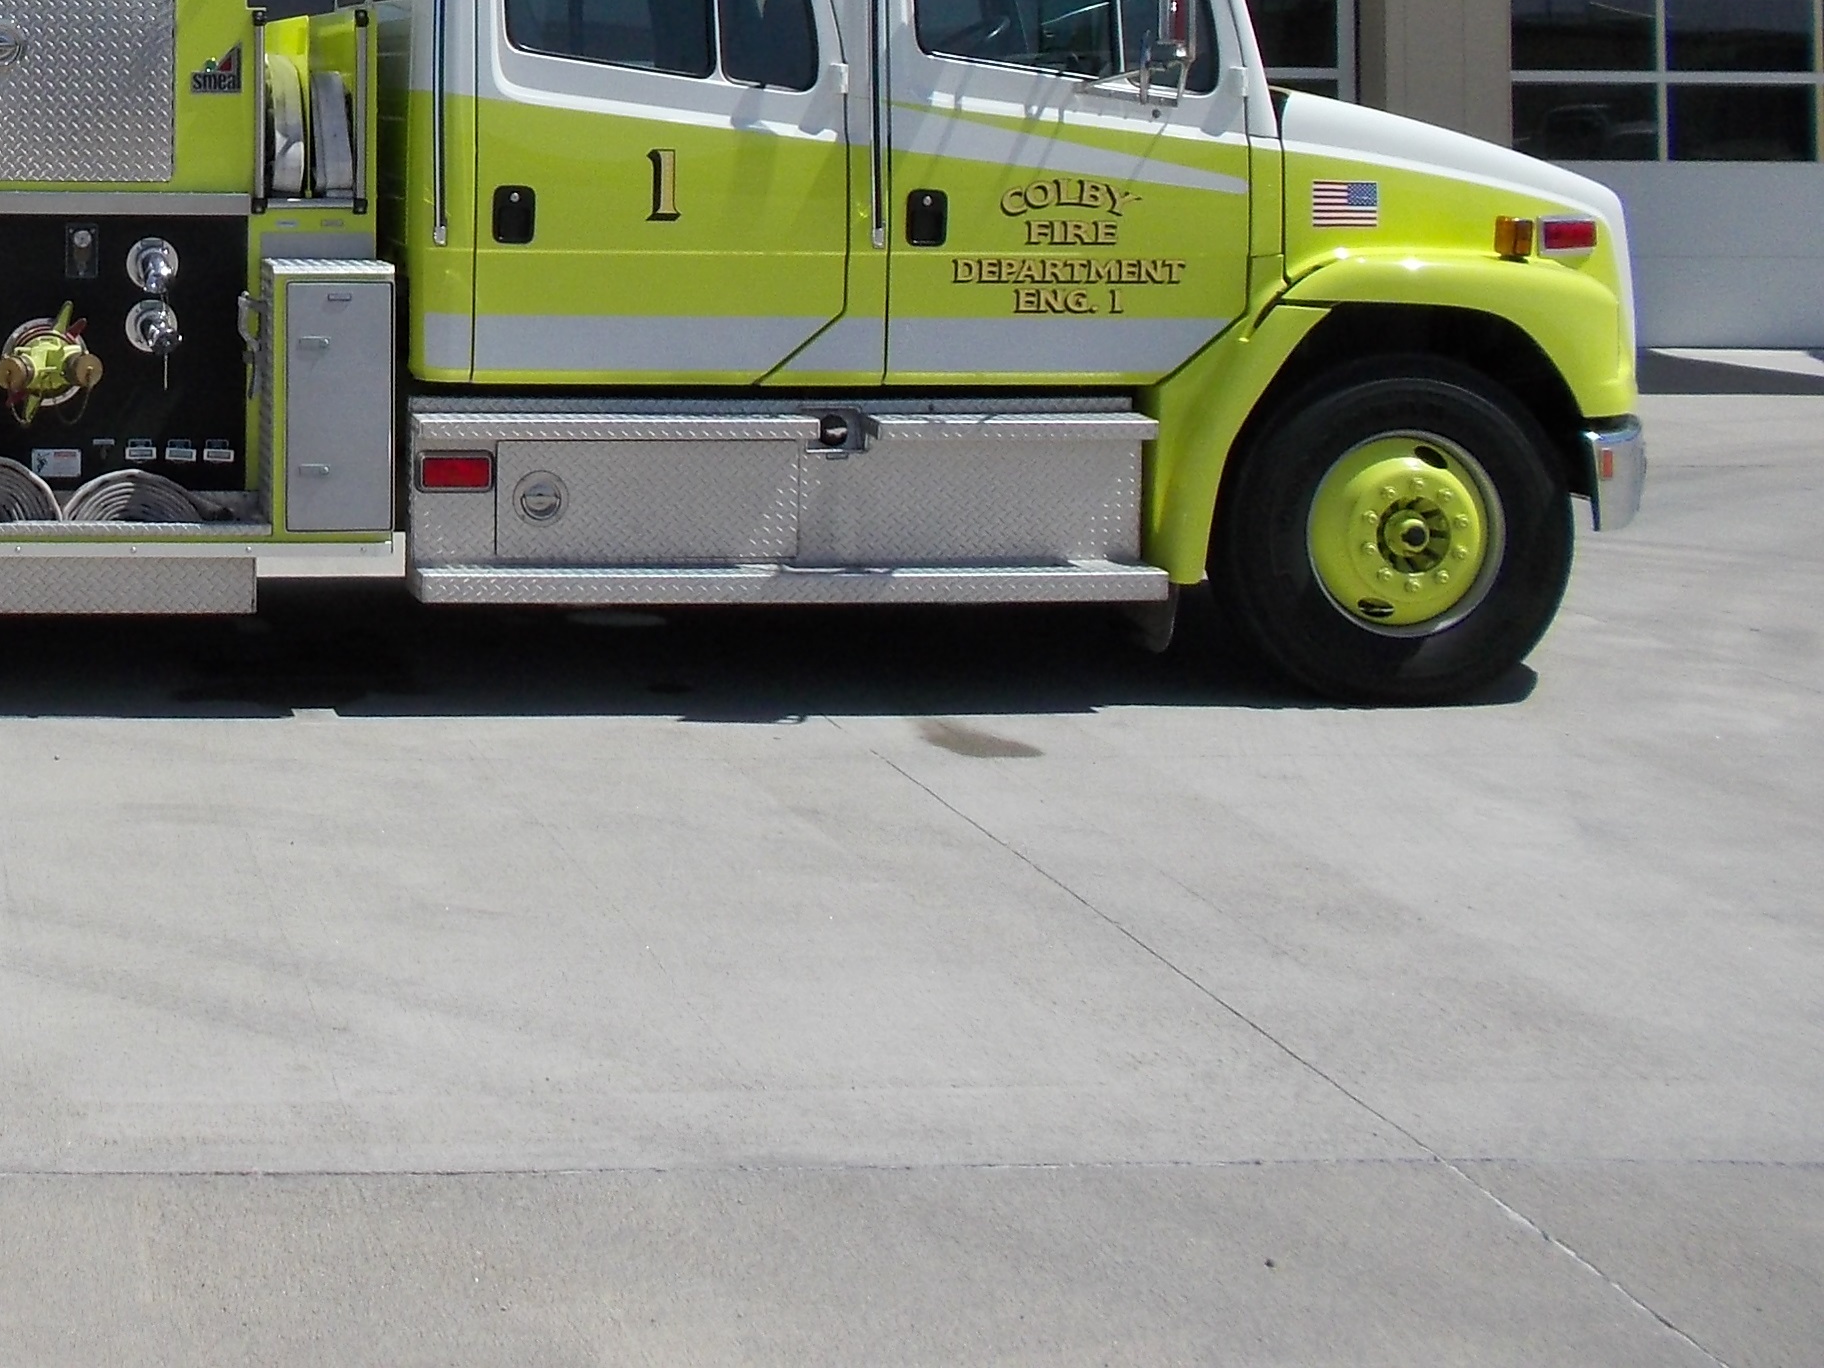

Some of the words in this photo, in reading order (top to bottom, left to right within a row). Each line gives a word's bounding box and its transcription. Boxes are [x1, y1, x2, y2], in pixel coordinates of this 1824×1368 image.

[646, 148, 682, 222] 1
[1001, 179, 1142, 216] COLBY
[1026, 220, 1117, 245] FIRE
[952, 258, 1185, 284] DEPARTMENT
[1013, 288, 1098, 314] ENG.
[1108, 289, 1124, 314] 1
